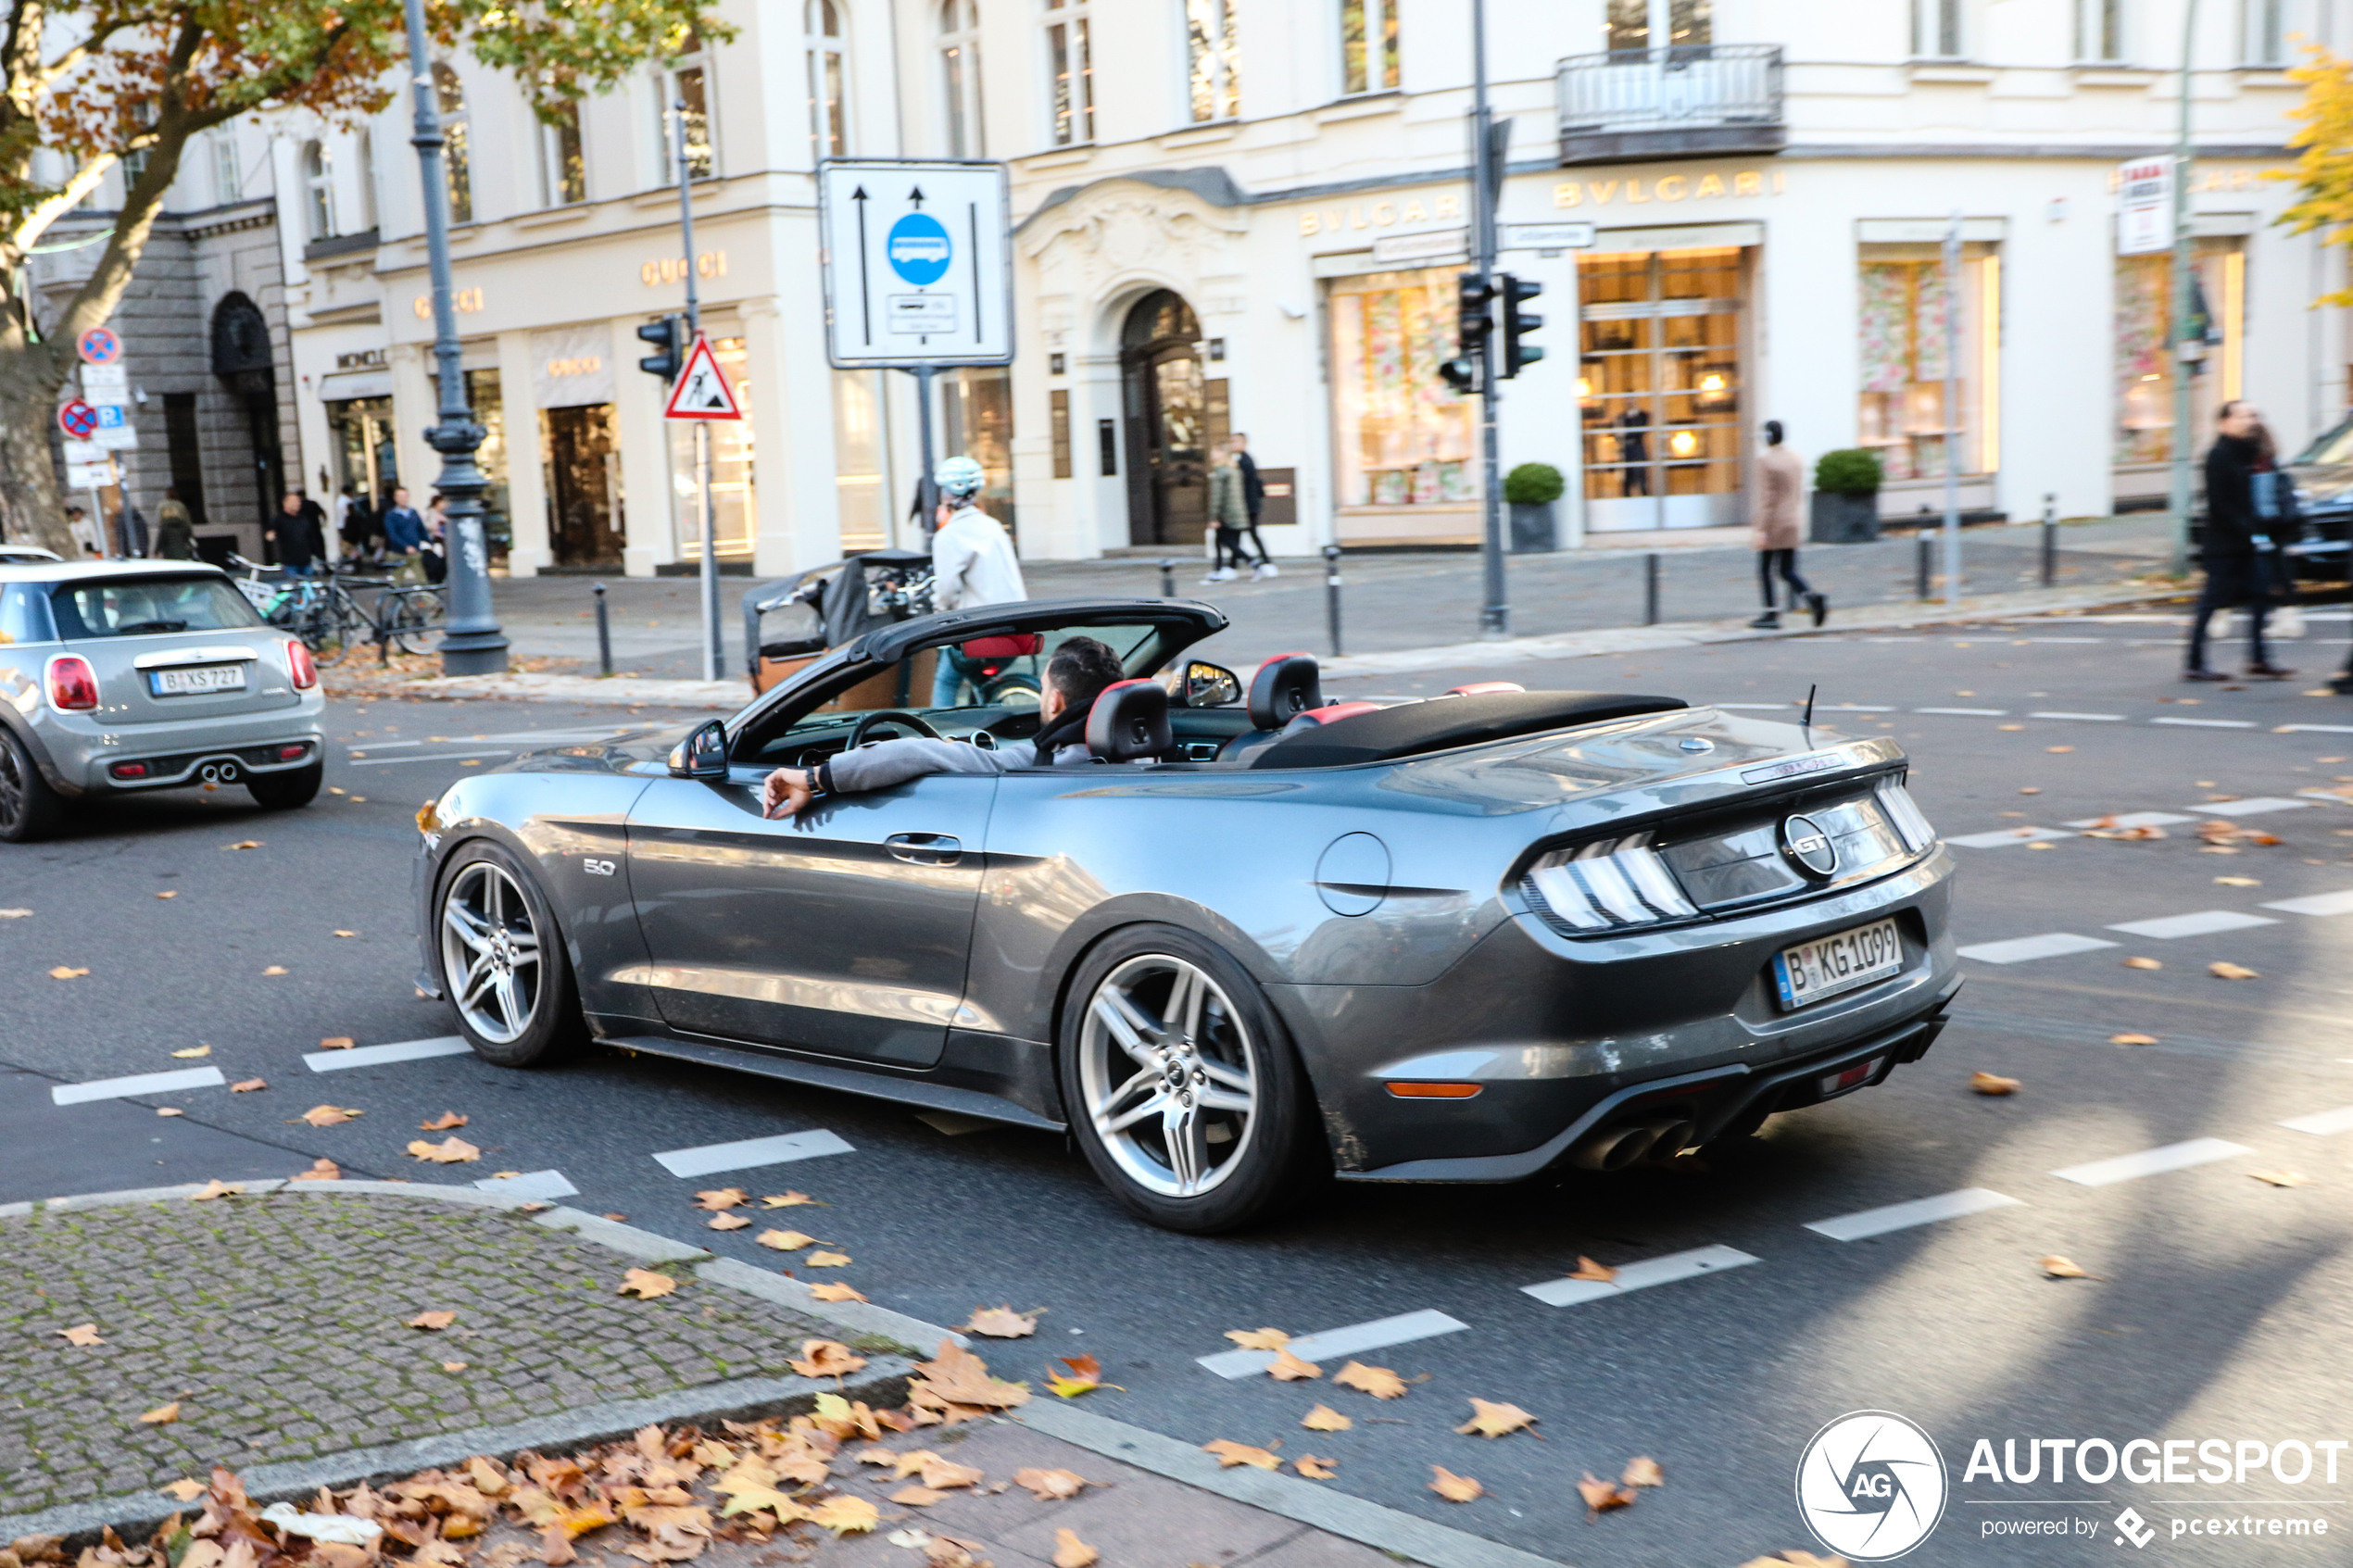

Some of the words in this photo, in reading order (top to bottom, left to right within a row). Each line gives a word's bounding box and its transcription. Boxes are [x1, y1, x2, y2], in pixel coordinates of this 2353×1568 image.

[1299, 193, 1462, 236] BVLGAR
[414, 286, 484, 320] GCI
[166, 673, 177, 689] B
[1793, 834, 1826, 854] GT
[1788, 951, 1806, 991] B
